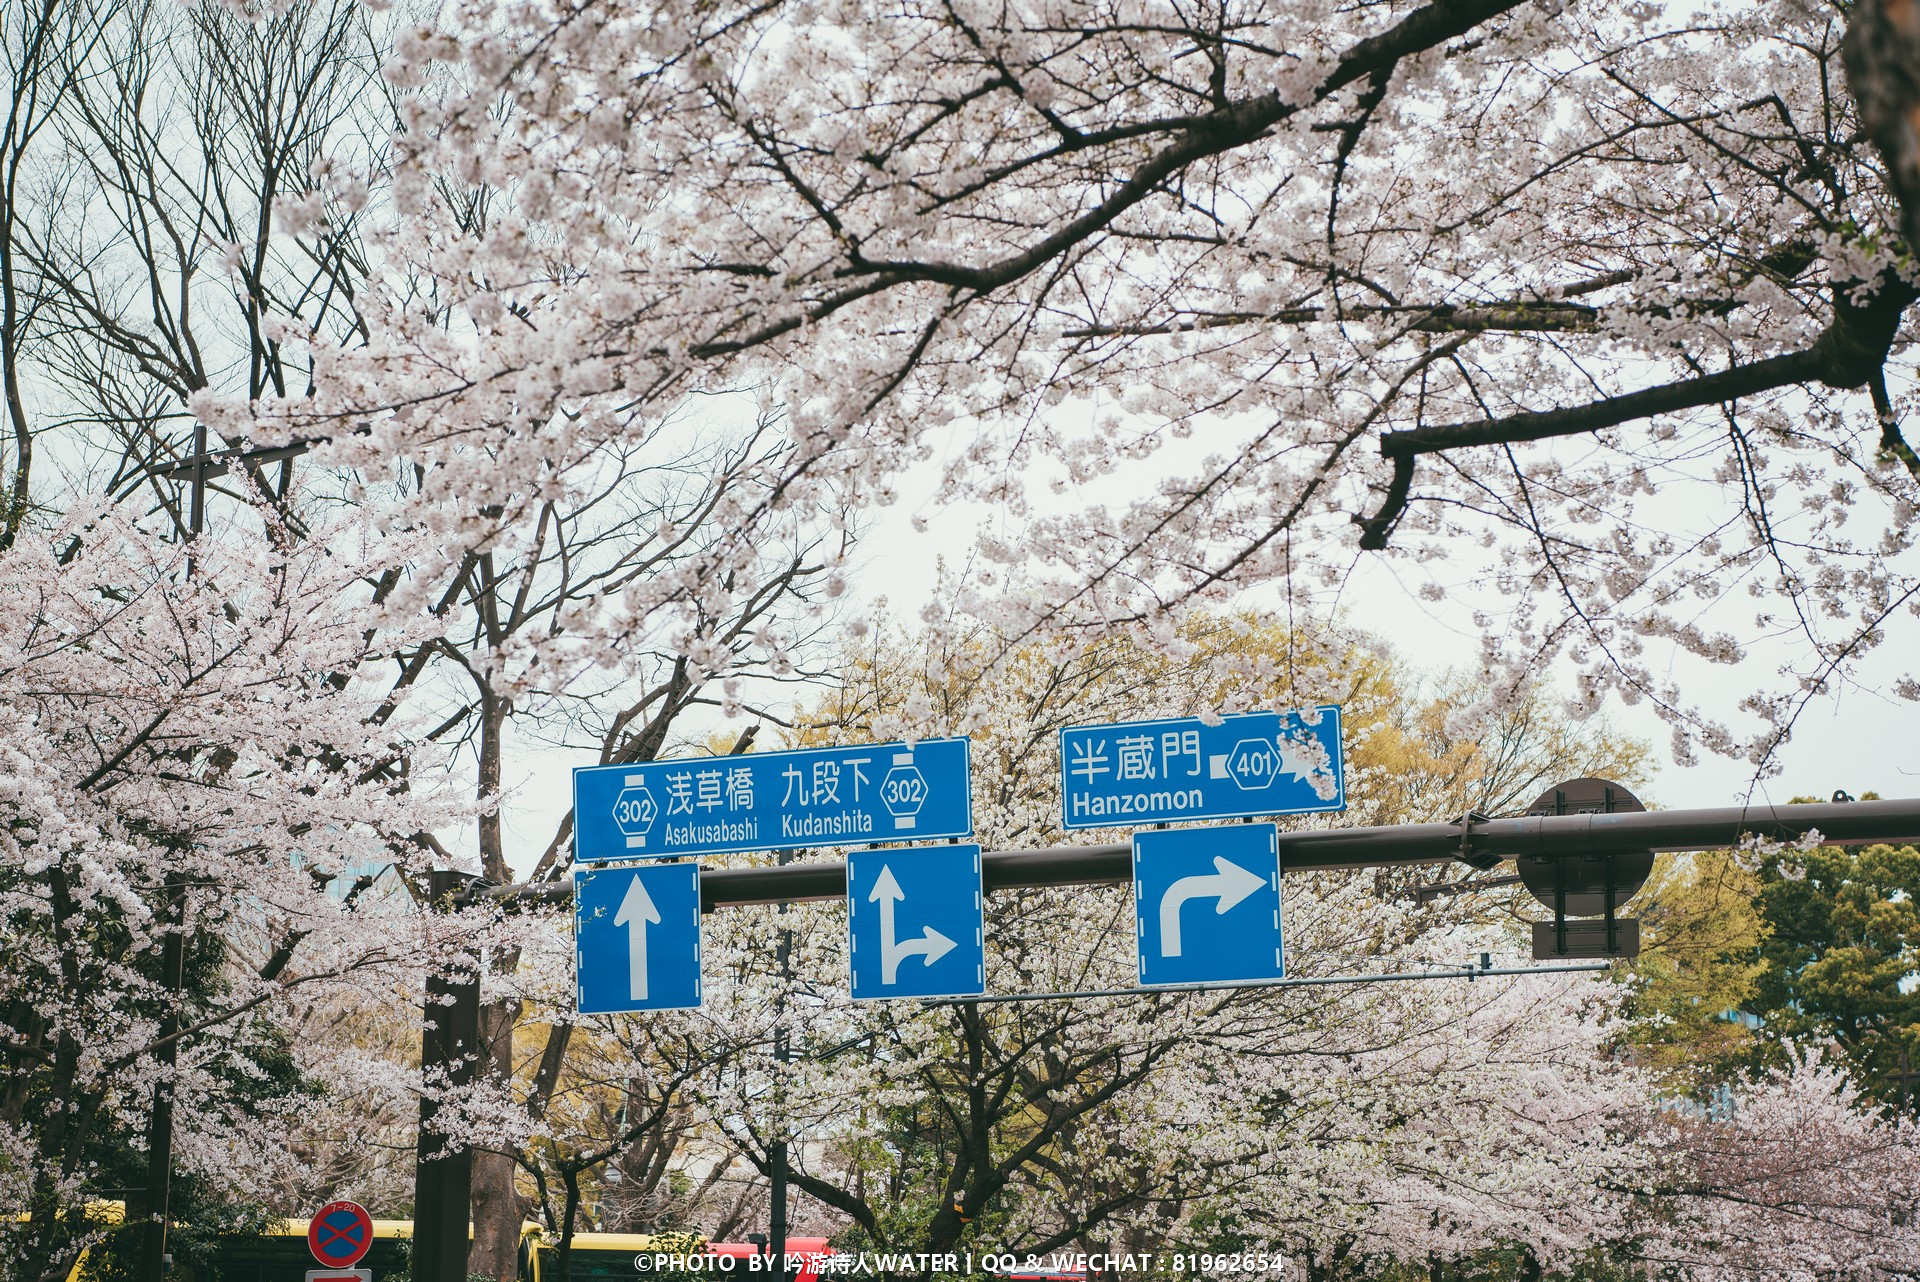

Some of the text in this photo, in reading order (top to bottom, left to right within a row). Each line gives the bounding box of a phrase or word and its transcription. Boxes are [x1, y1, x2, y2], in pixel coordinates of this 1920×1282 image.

[1071, 730, 1201, 785] 半蔵門
[1236, 750, 1272, 777] 401
[665, 766, 755, 816] 浅草橋
[781, 757, 871, 807] 九段下
[887, 778, 921, 804] 302
[619, 801, 652, 824] 302
[1073, 788, 1204, 817] Hanzomon
[664, 815, 759, 846] Asakusabashi
[781, 809, 873, 838] Kudanshita
[331, 1203, 355, 1212] 7-20
